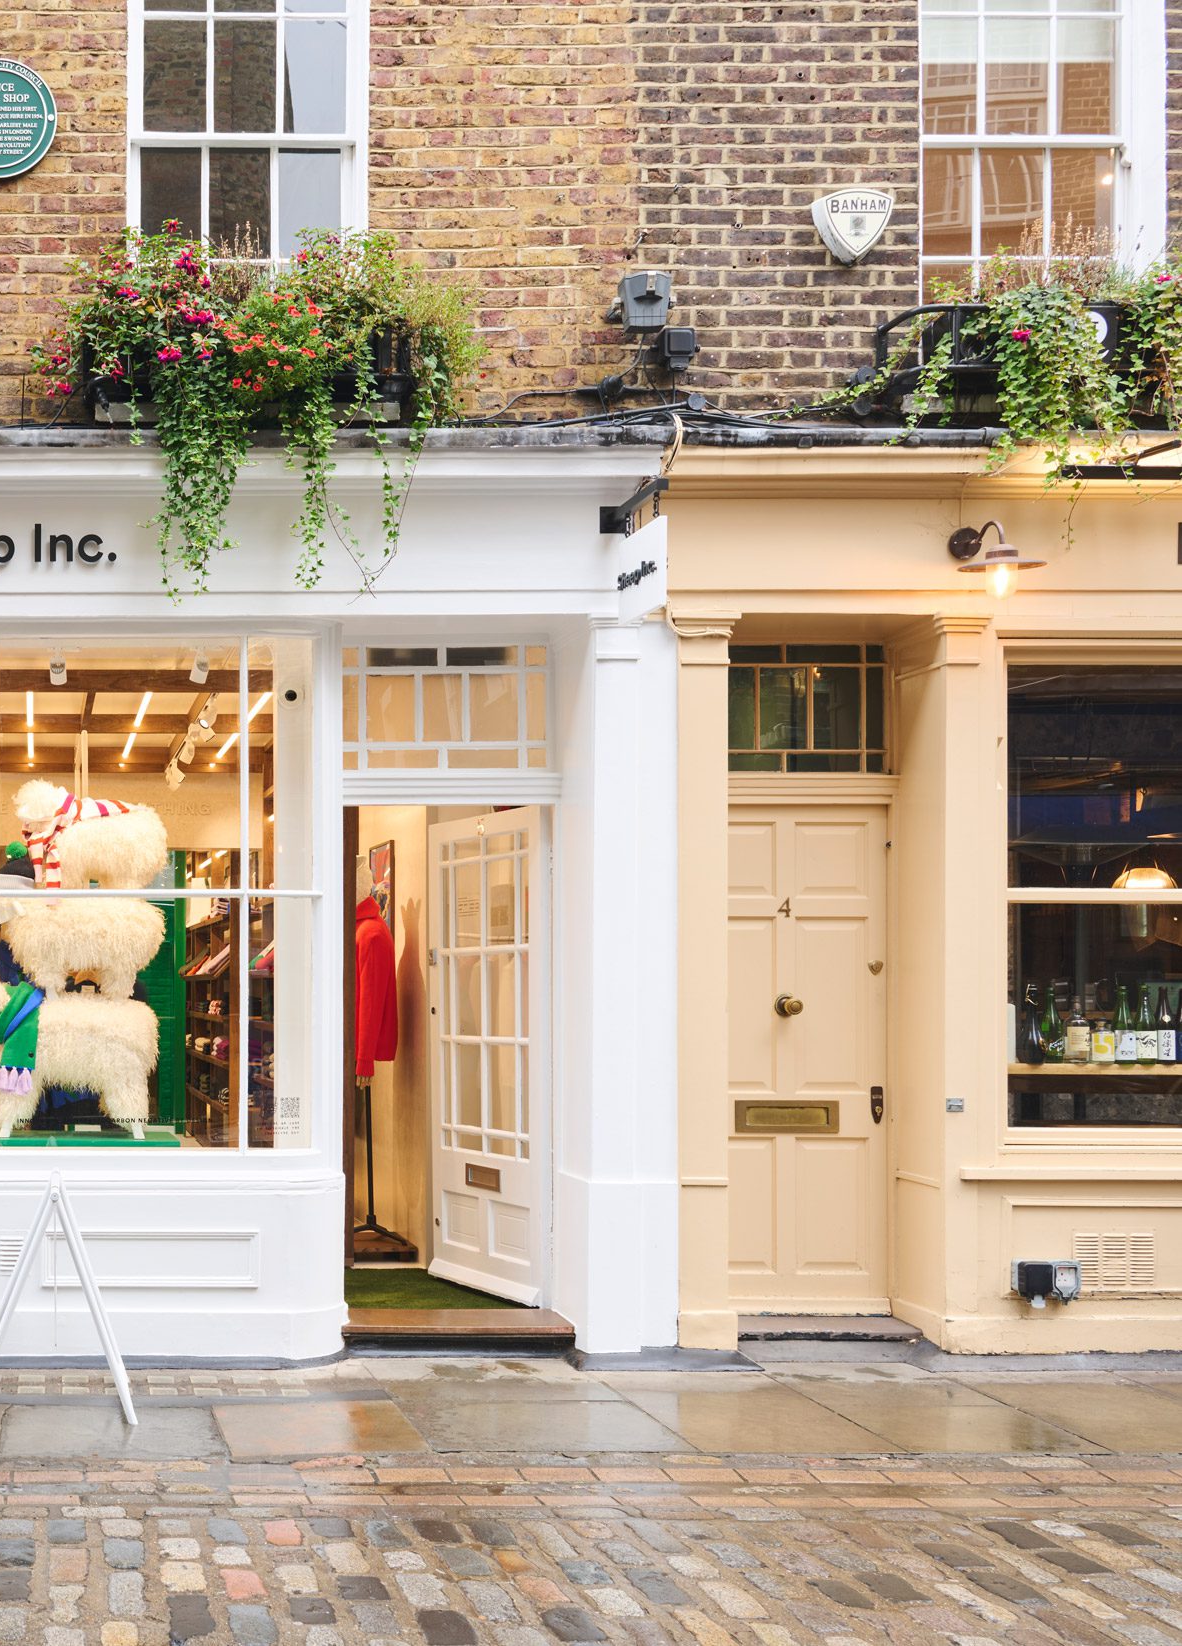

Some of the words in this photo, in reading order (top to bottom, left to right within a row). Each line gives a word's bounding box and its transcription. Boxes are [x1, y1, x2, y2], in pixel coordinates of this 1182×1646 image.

[15, 65, 43, 89] COUNCIL
[3, 94, 30, 103] SHOP
[831, 199, 887, 214] BANHAM
[34, 523, 117, 562] Inc.
[617, 569, 642, 591] Sheep
[777, 896, 792, 918] 4
